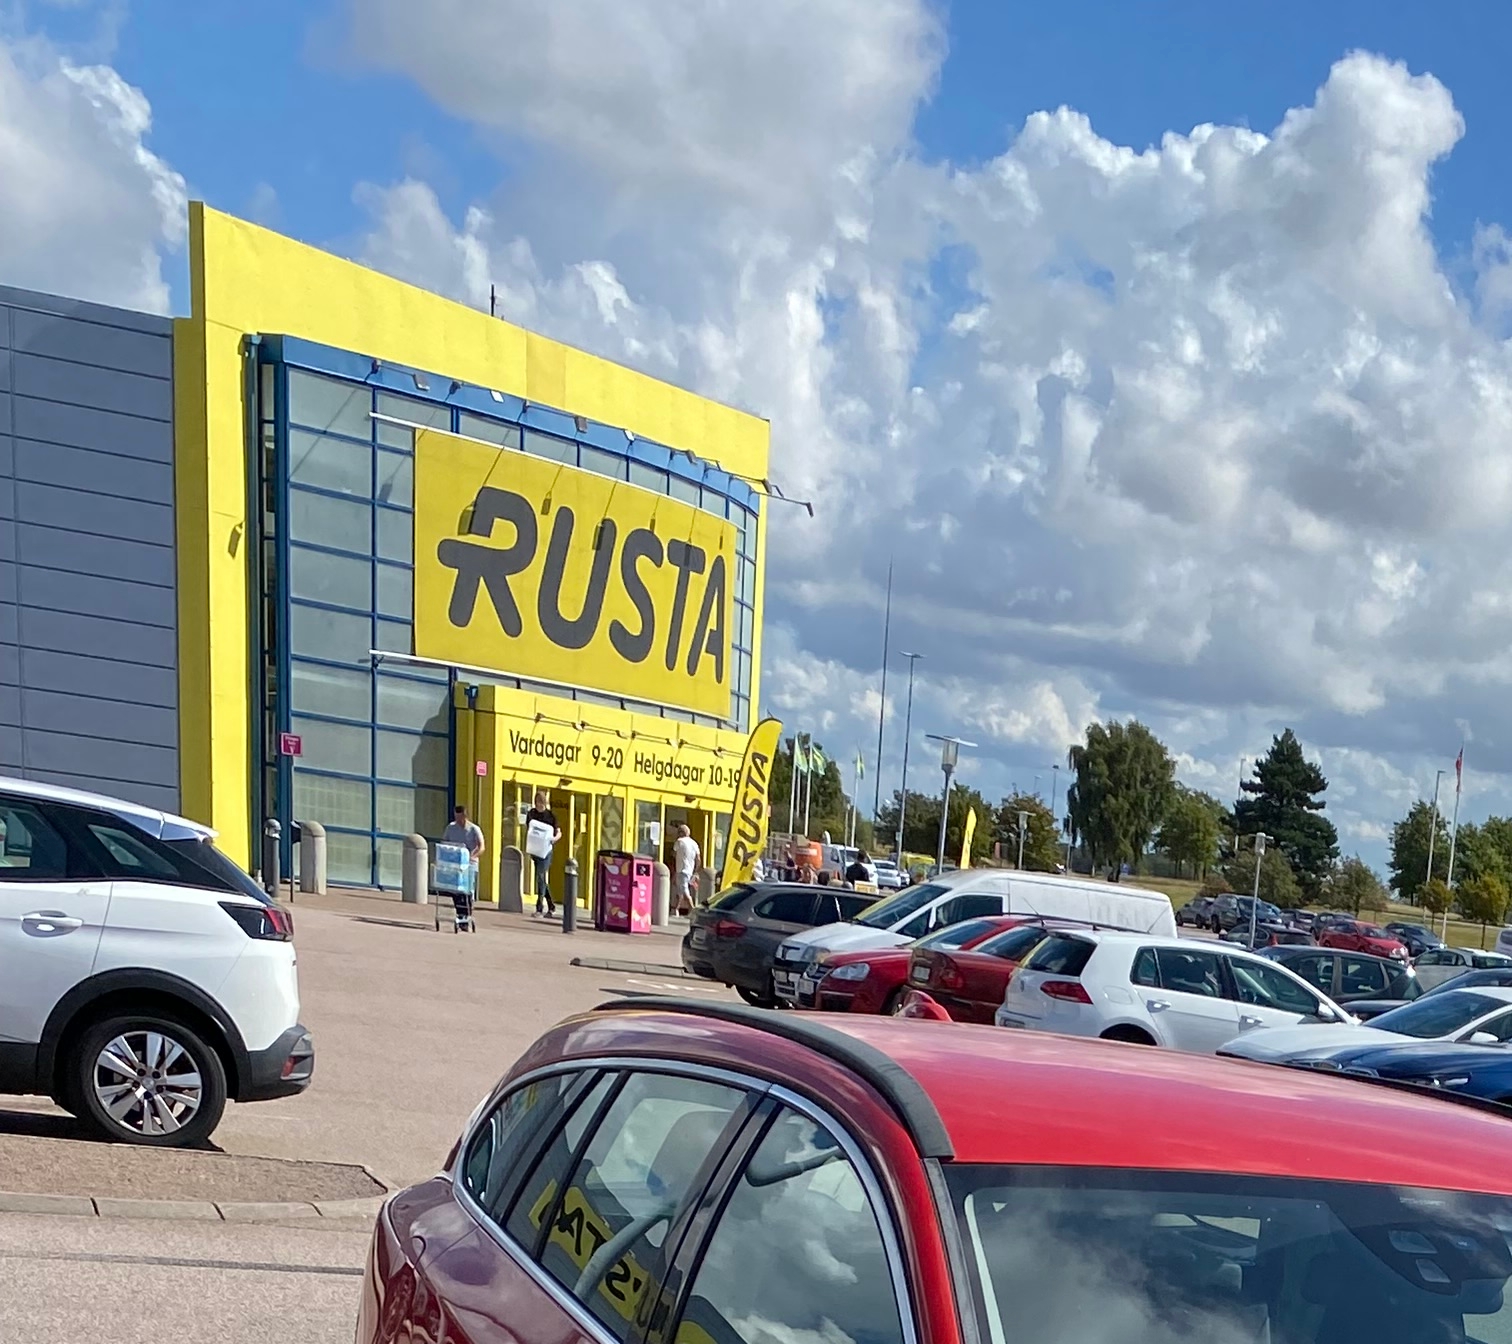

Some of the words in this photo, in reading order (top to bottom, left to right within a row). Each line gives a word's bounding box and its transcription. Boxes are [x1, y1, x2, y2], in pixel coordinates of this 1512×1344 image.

[437, 486, 726, 684] RUSTA
[509, 729, 581, 765] Vardagar
[591, 745, 623, 769] 9-20
[634, 751, 704, 787] Helgdagar
[732, 752, 768, 870] RUSTA
